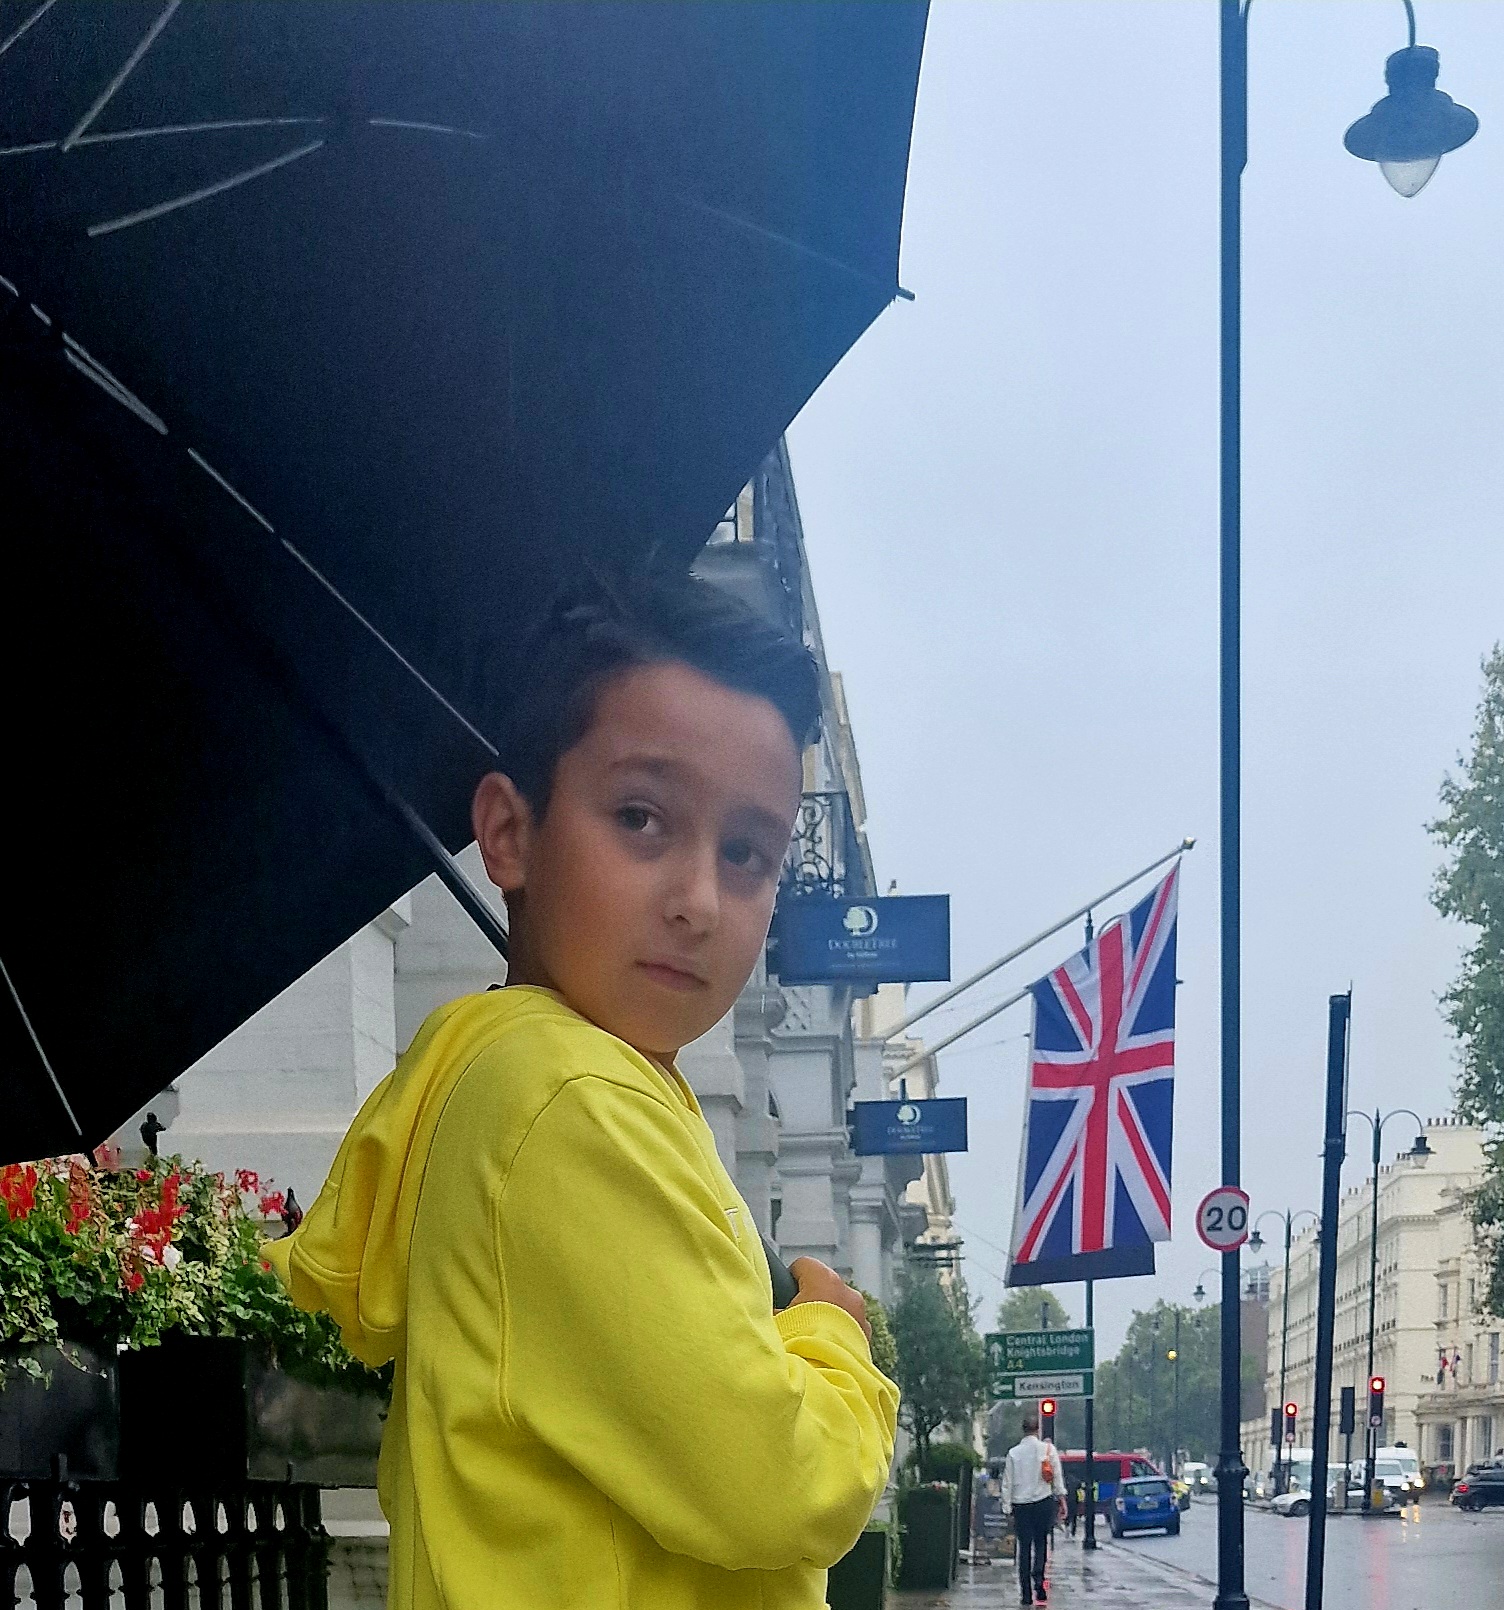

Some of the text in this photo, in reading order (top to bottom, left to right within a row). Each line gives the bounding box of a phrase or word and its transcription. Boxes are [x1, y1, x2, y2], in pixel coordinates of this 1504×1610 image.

[1206, 1206, 1247, 1232] 20
[1006, 1333, 1089, 1346] Central London
[1006, 1346, 1080, 1358] Knightsbridge
[1006, 1359, 1024, 1369] A4
[1019, 1380, 1079, 1391] Kensington
